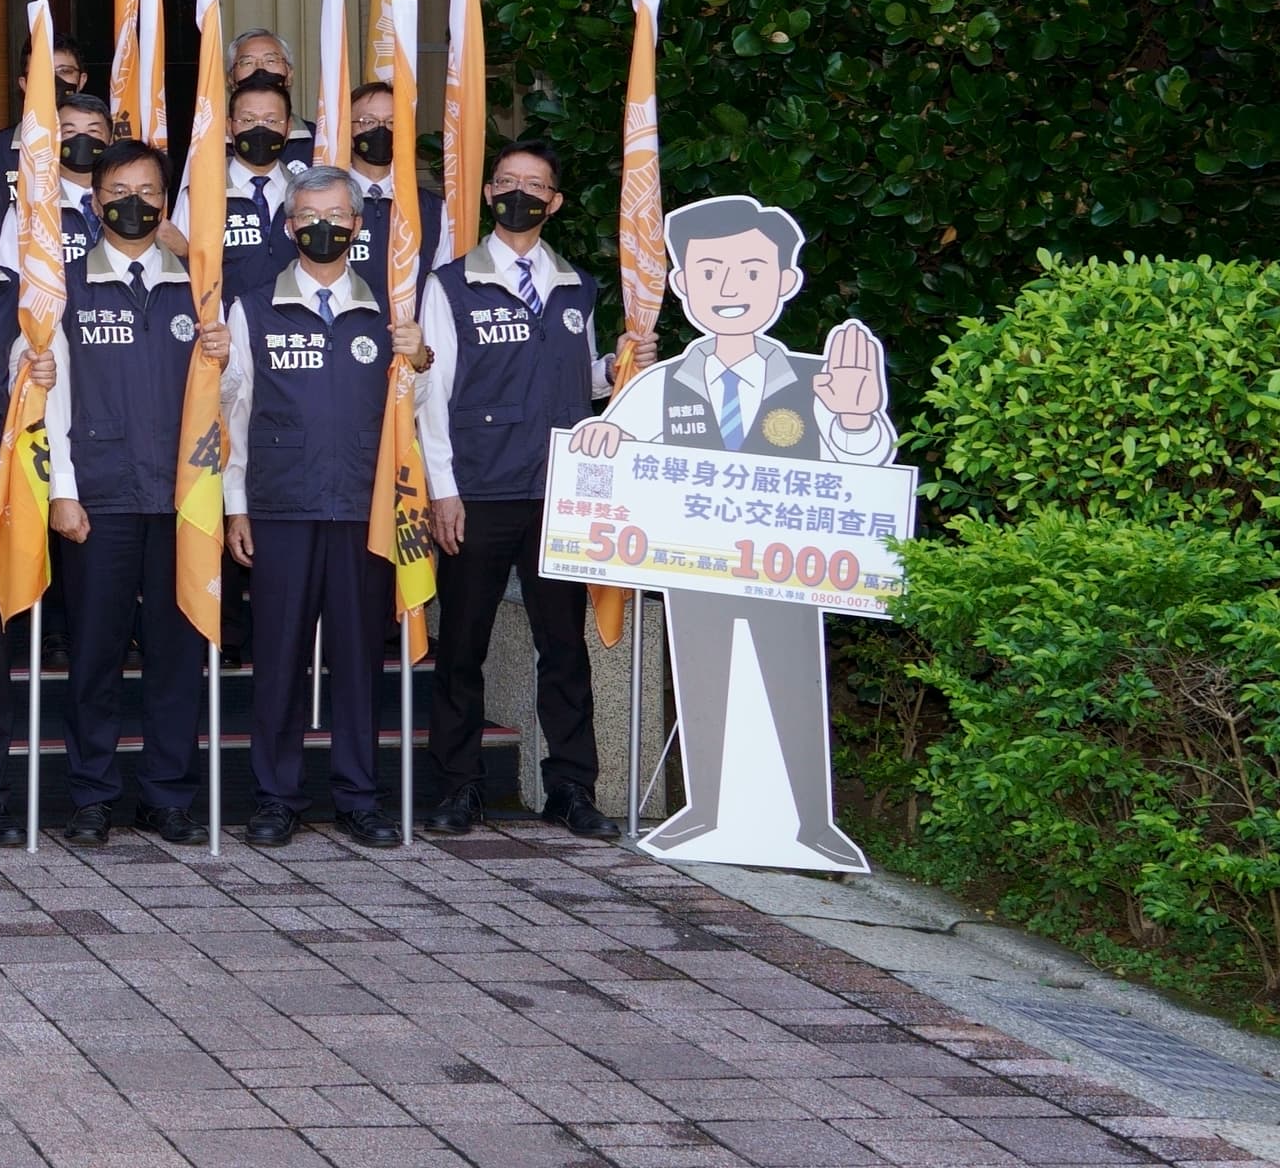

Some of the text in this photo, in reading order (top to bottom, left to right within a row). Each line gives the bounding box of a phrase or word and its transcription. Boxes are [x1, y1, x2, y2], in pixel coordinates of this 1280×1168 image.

[77, 310, 134, 324] 調查局
[470, 307, 530, 324] 調查局
[80, 326, 134, 344] MJIB
[265, 334, 325, 348] 調查局
[476, 324, 530, 344] MJIB
[269, 351, 323, 369] MJIB
[668, 404, 705, 418] 調查局
[671, 421, 707, 436] MJIB
[556, 498, 631, 522] 檢舉獎金
[684, 493, 897, 539] 安心交給調查局
[585, 521, 649, 566] 50
[731, 539, 860, 591] 1000
